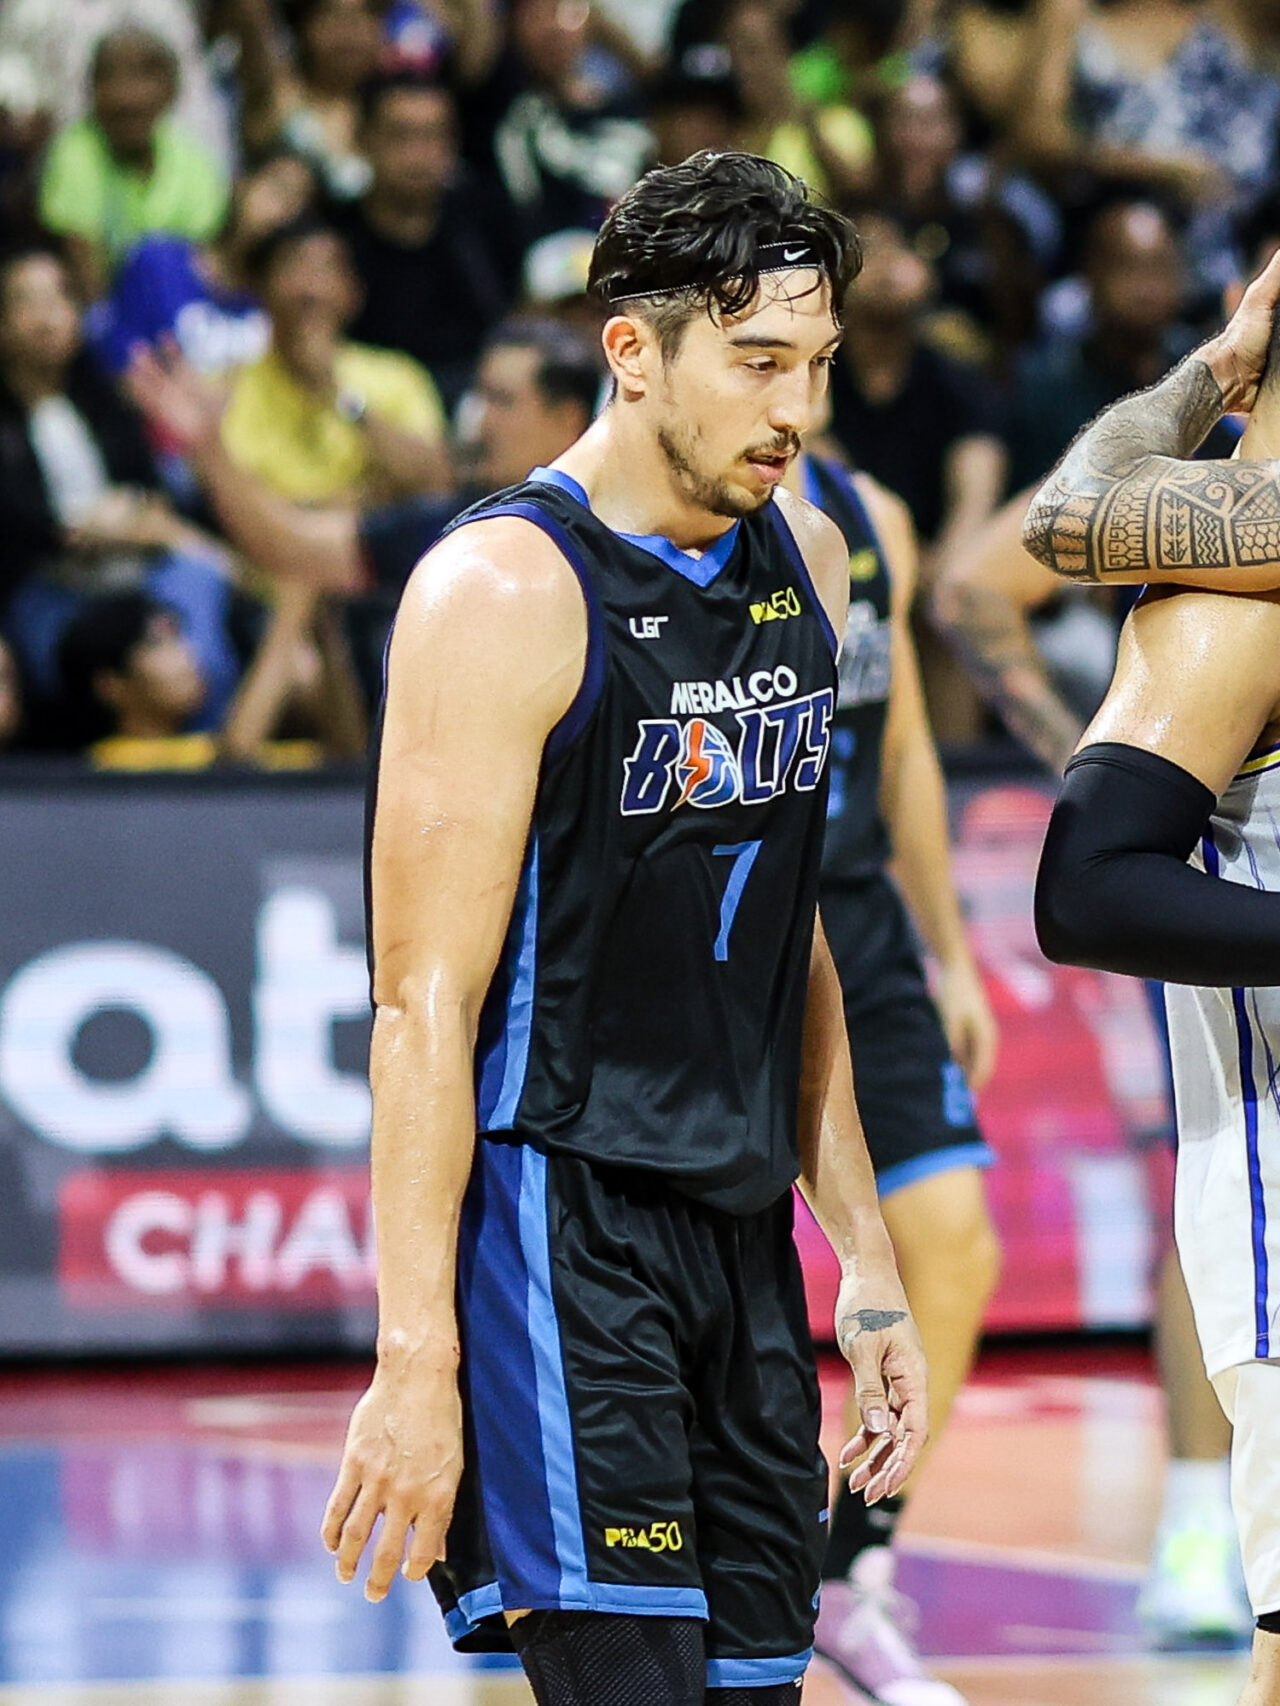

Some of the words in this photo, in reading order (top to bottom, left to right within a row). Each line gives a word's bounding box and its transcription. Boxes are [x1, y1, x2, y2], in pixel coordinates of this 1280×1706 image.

[670, 665, 798, 715] MERALCO
[620, 687, 834, 816] BOLTS
[712, 839, 763, 962] 7
[104, 1188, 378, 1292] CHA
